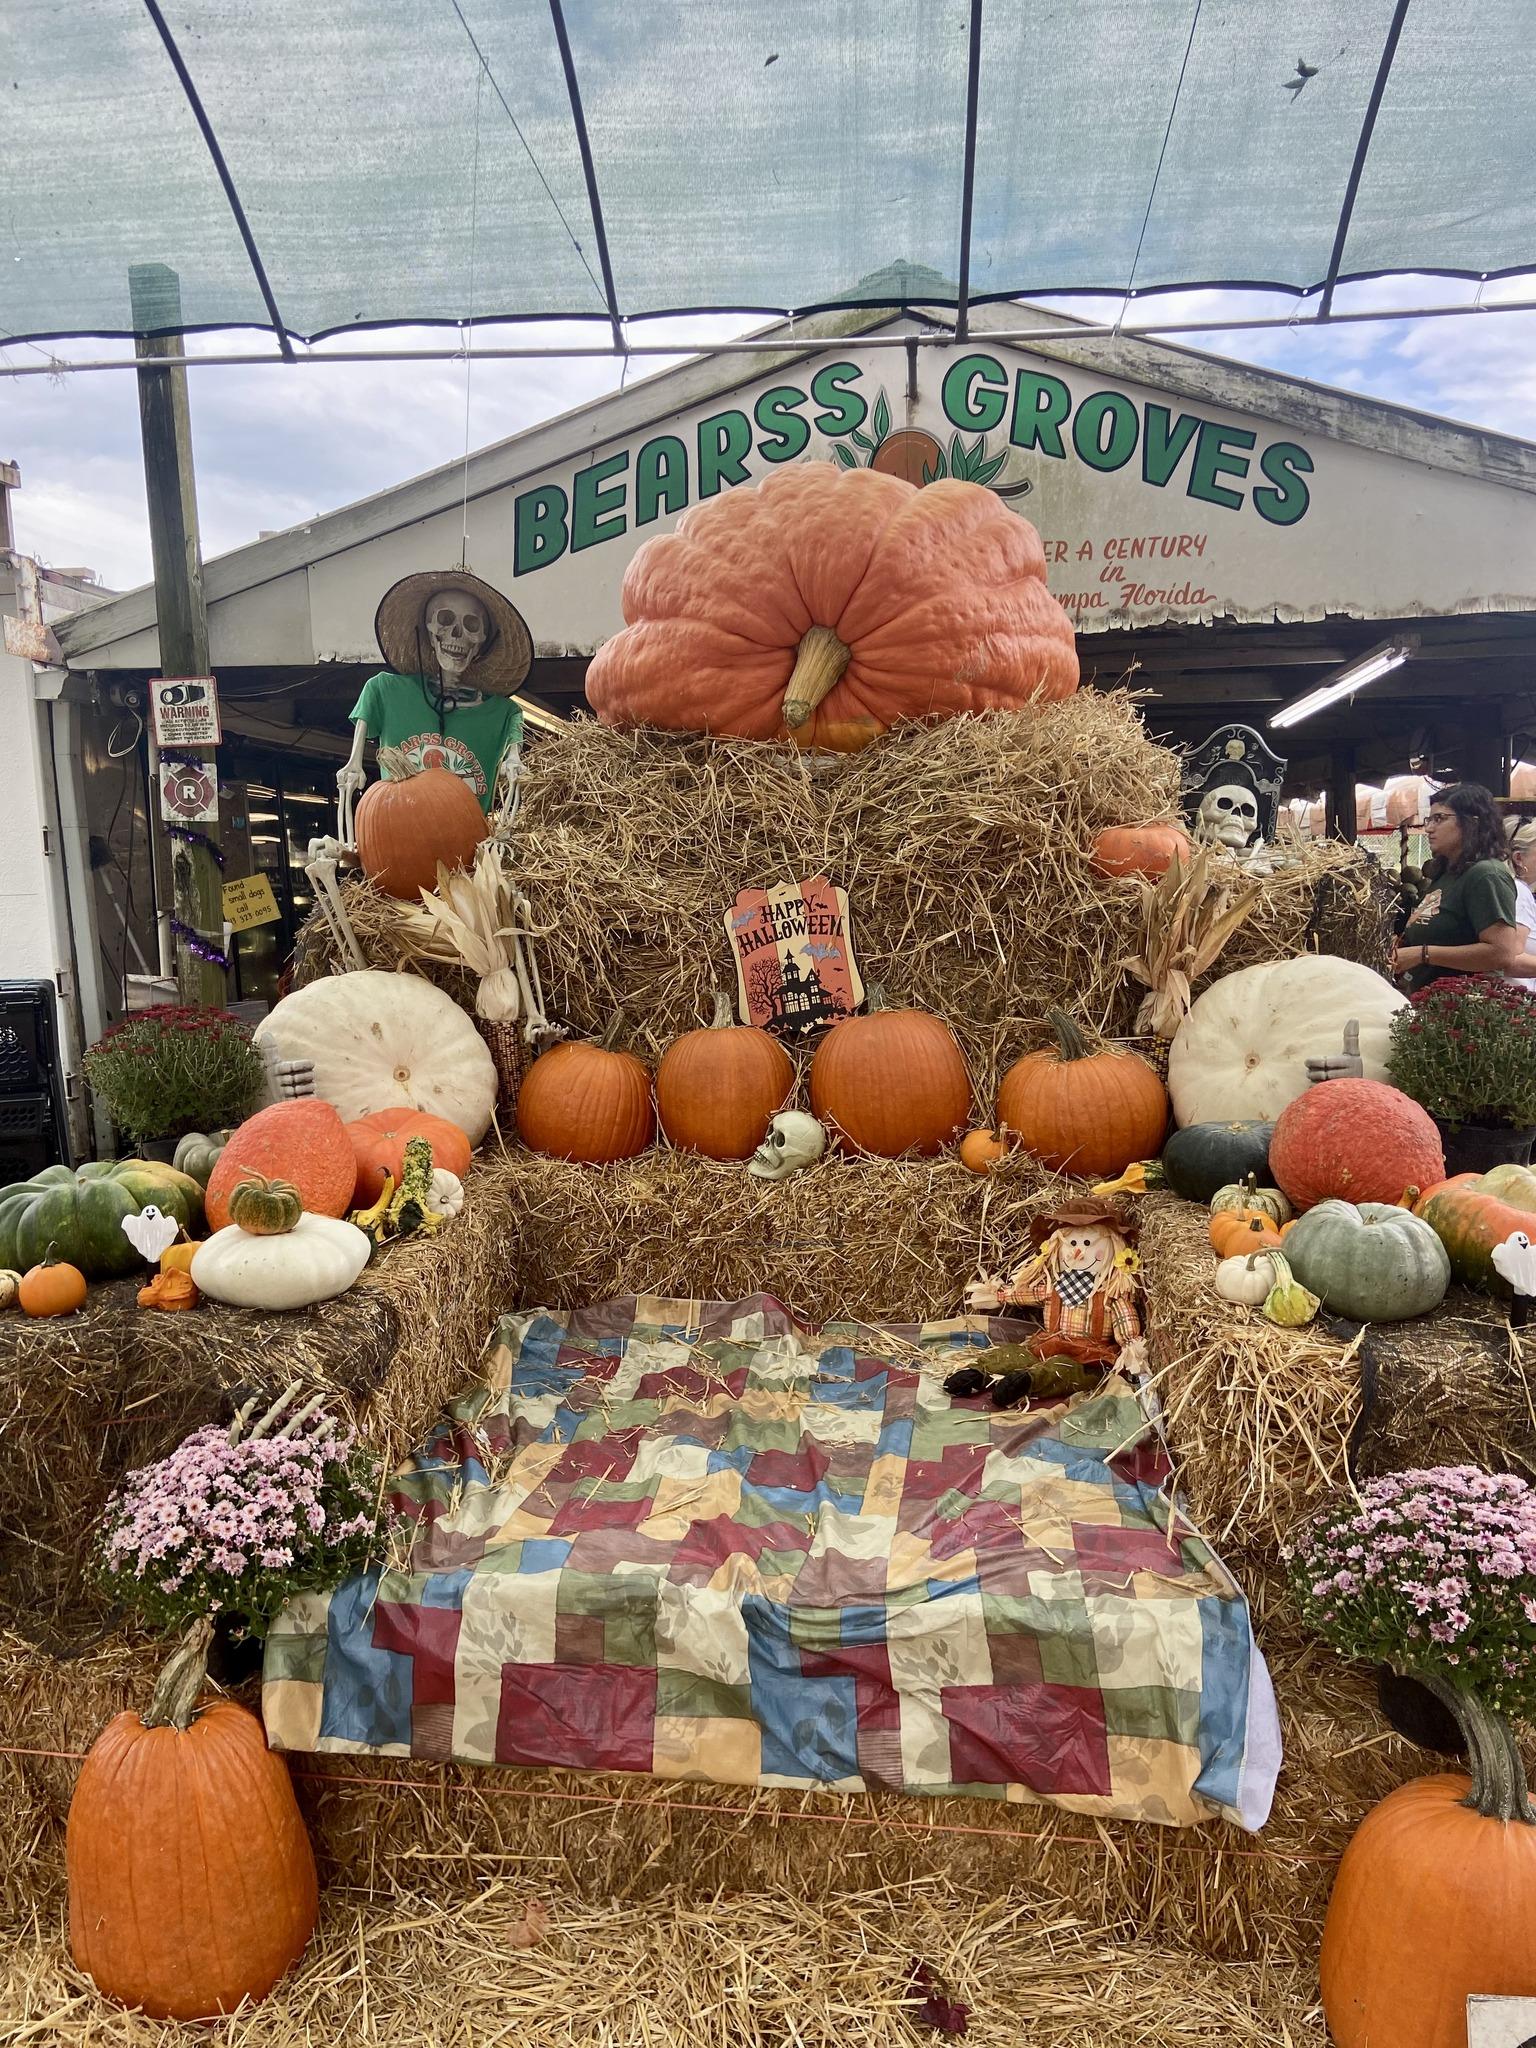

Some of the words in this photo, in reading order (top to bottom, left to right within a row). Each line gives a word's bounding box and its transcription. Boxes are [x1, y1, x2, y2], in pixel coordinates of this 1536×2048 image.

[513, 361, 869, 577] BEARSS
[941, 353, 1315, 527] GROVES
[1042, 540, 1069, 563] ER
[1075, 539, 1093, 562] A
[1103, 534, 1208, 560] CENTURY
[1099, 561, 1126, 583] in
[1119, 582, 1217, 609] Florida
[160, 705, 209, 719] WARNING
[397, 732, 443, 754] ARSS
[443, 736, 488, 795] GROVES
[182, 785, 197, 800] R
[228, 891, 247, 904] small
[248, 888, 266, 899] dogs
[236, 903, 249, 914] call
[759, 894, 816, 924] HAPPY
[229, 917, 237, 925] 13
[735, 914, 844, 958] HALLOWEEN
